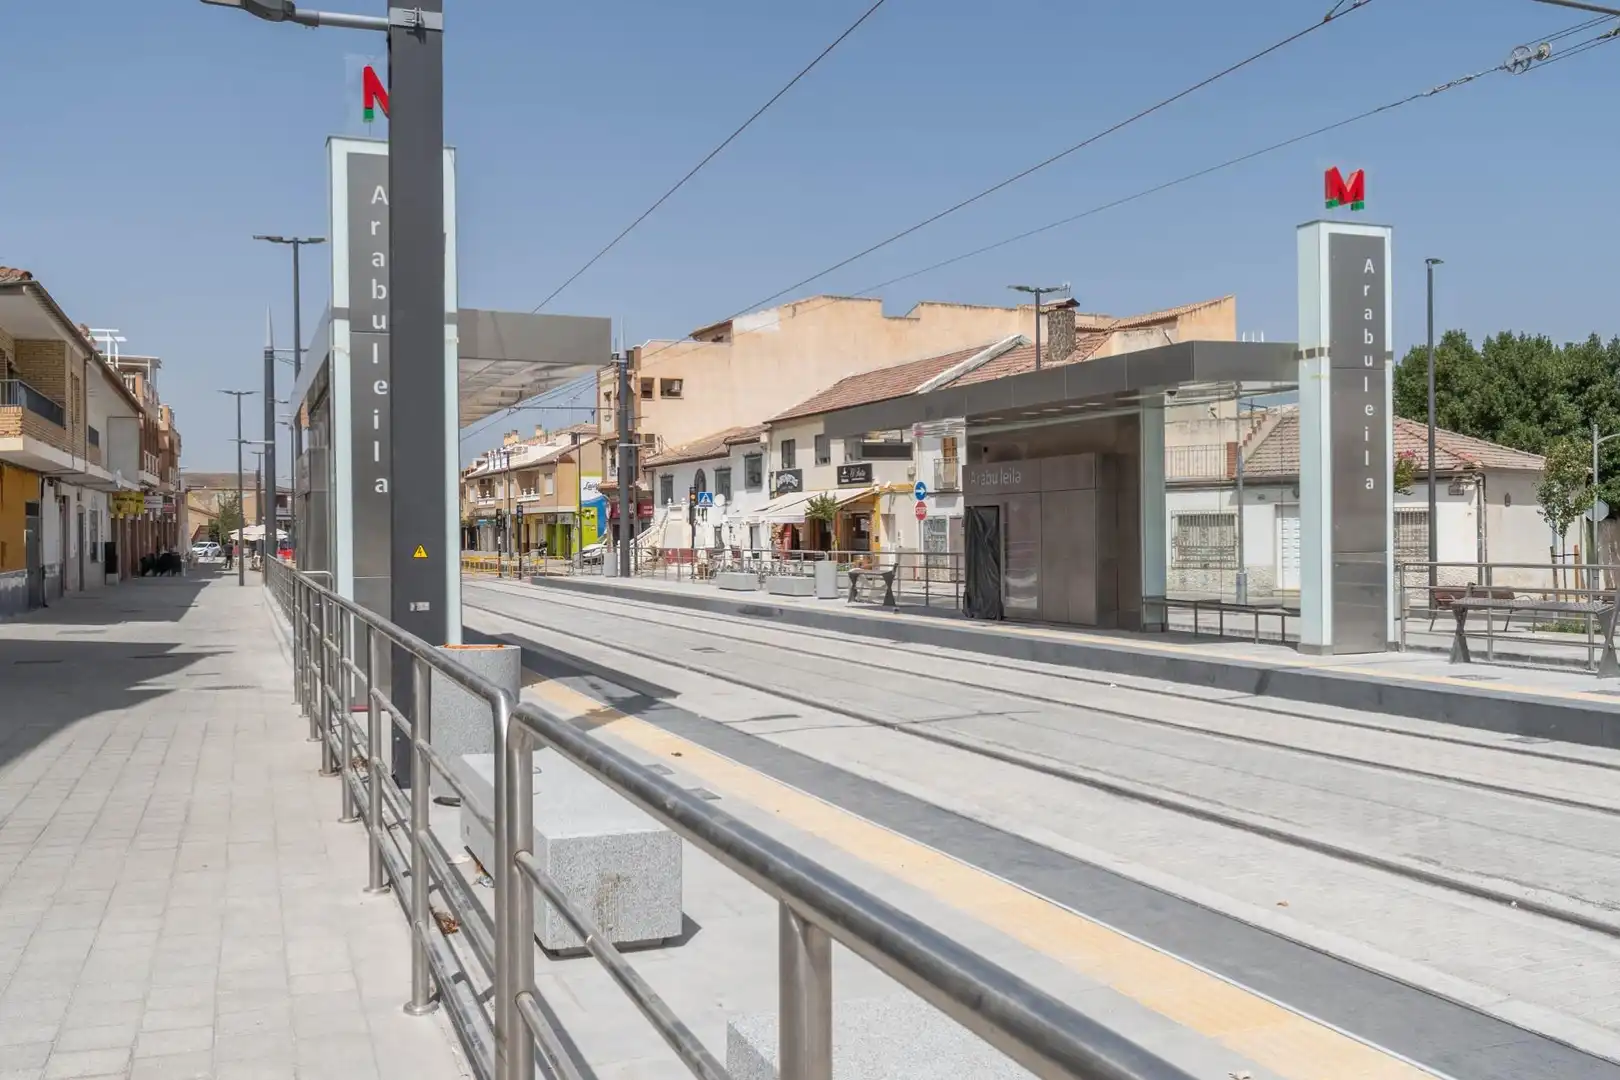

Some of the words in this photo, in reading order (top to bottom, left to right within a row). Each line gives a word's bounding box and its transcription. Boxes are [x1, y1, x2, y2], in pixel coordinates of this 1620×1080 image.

[1325, 166, 1365, 210] M
[371, 185, 389, 493] Arabuleila
[1364, 258, 1375, 490] Arabuleila
[970, 467, 1021, 486] Arabuleila
